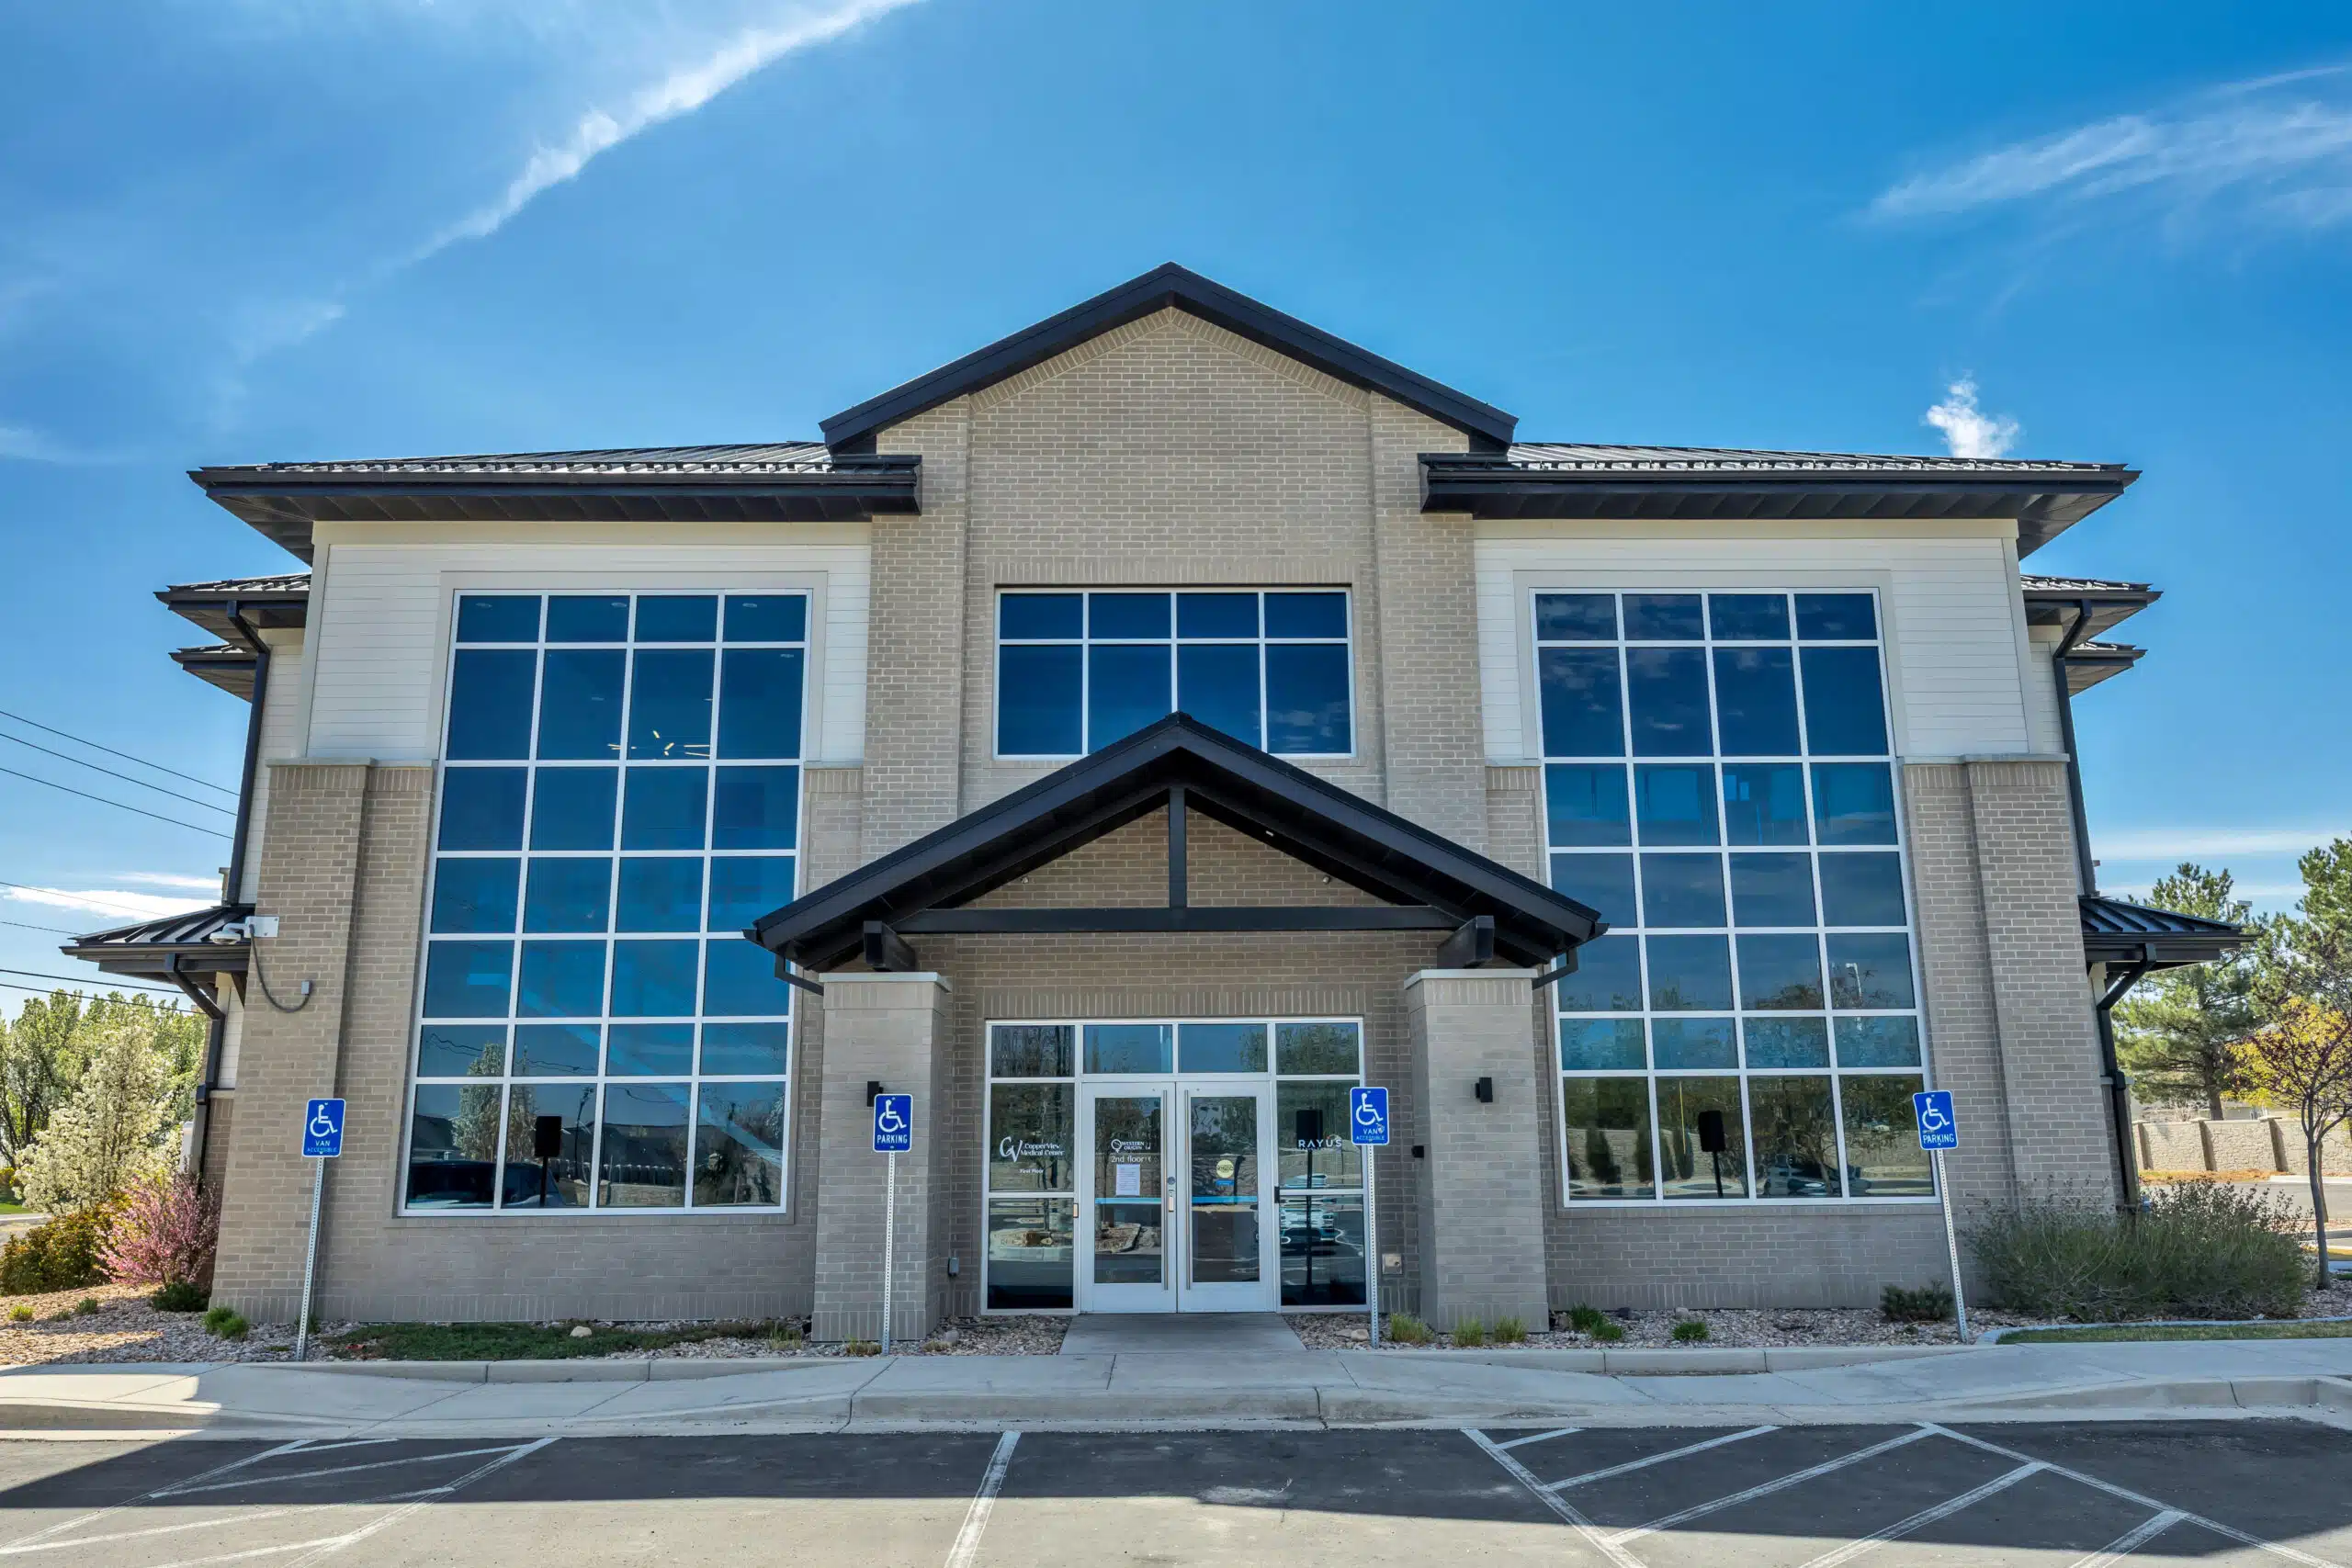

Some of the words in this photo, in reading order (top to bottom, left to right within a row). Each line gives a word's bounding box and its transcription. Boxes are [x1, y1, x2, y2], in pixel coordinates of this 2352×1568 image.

[876, 1134, 908, 1144] PARKING
[1922, 1133, 1955, 1144] PARKING
[1297, 1139, 1342, 1148] RAYUS
[1127, 1155, 1145, 1163] floor
